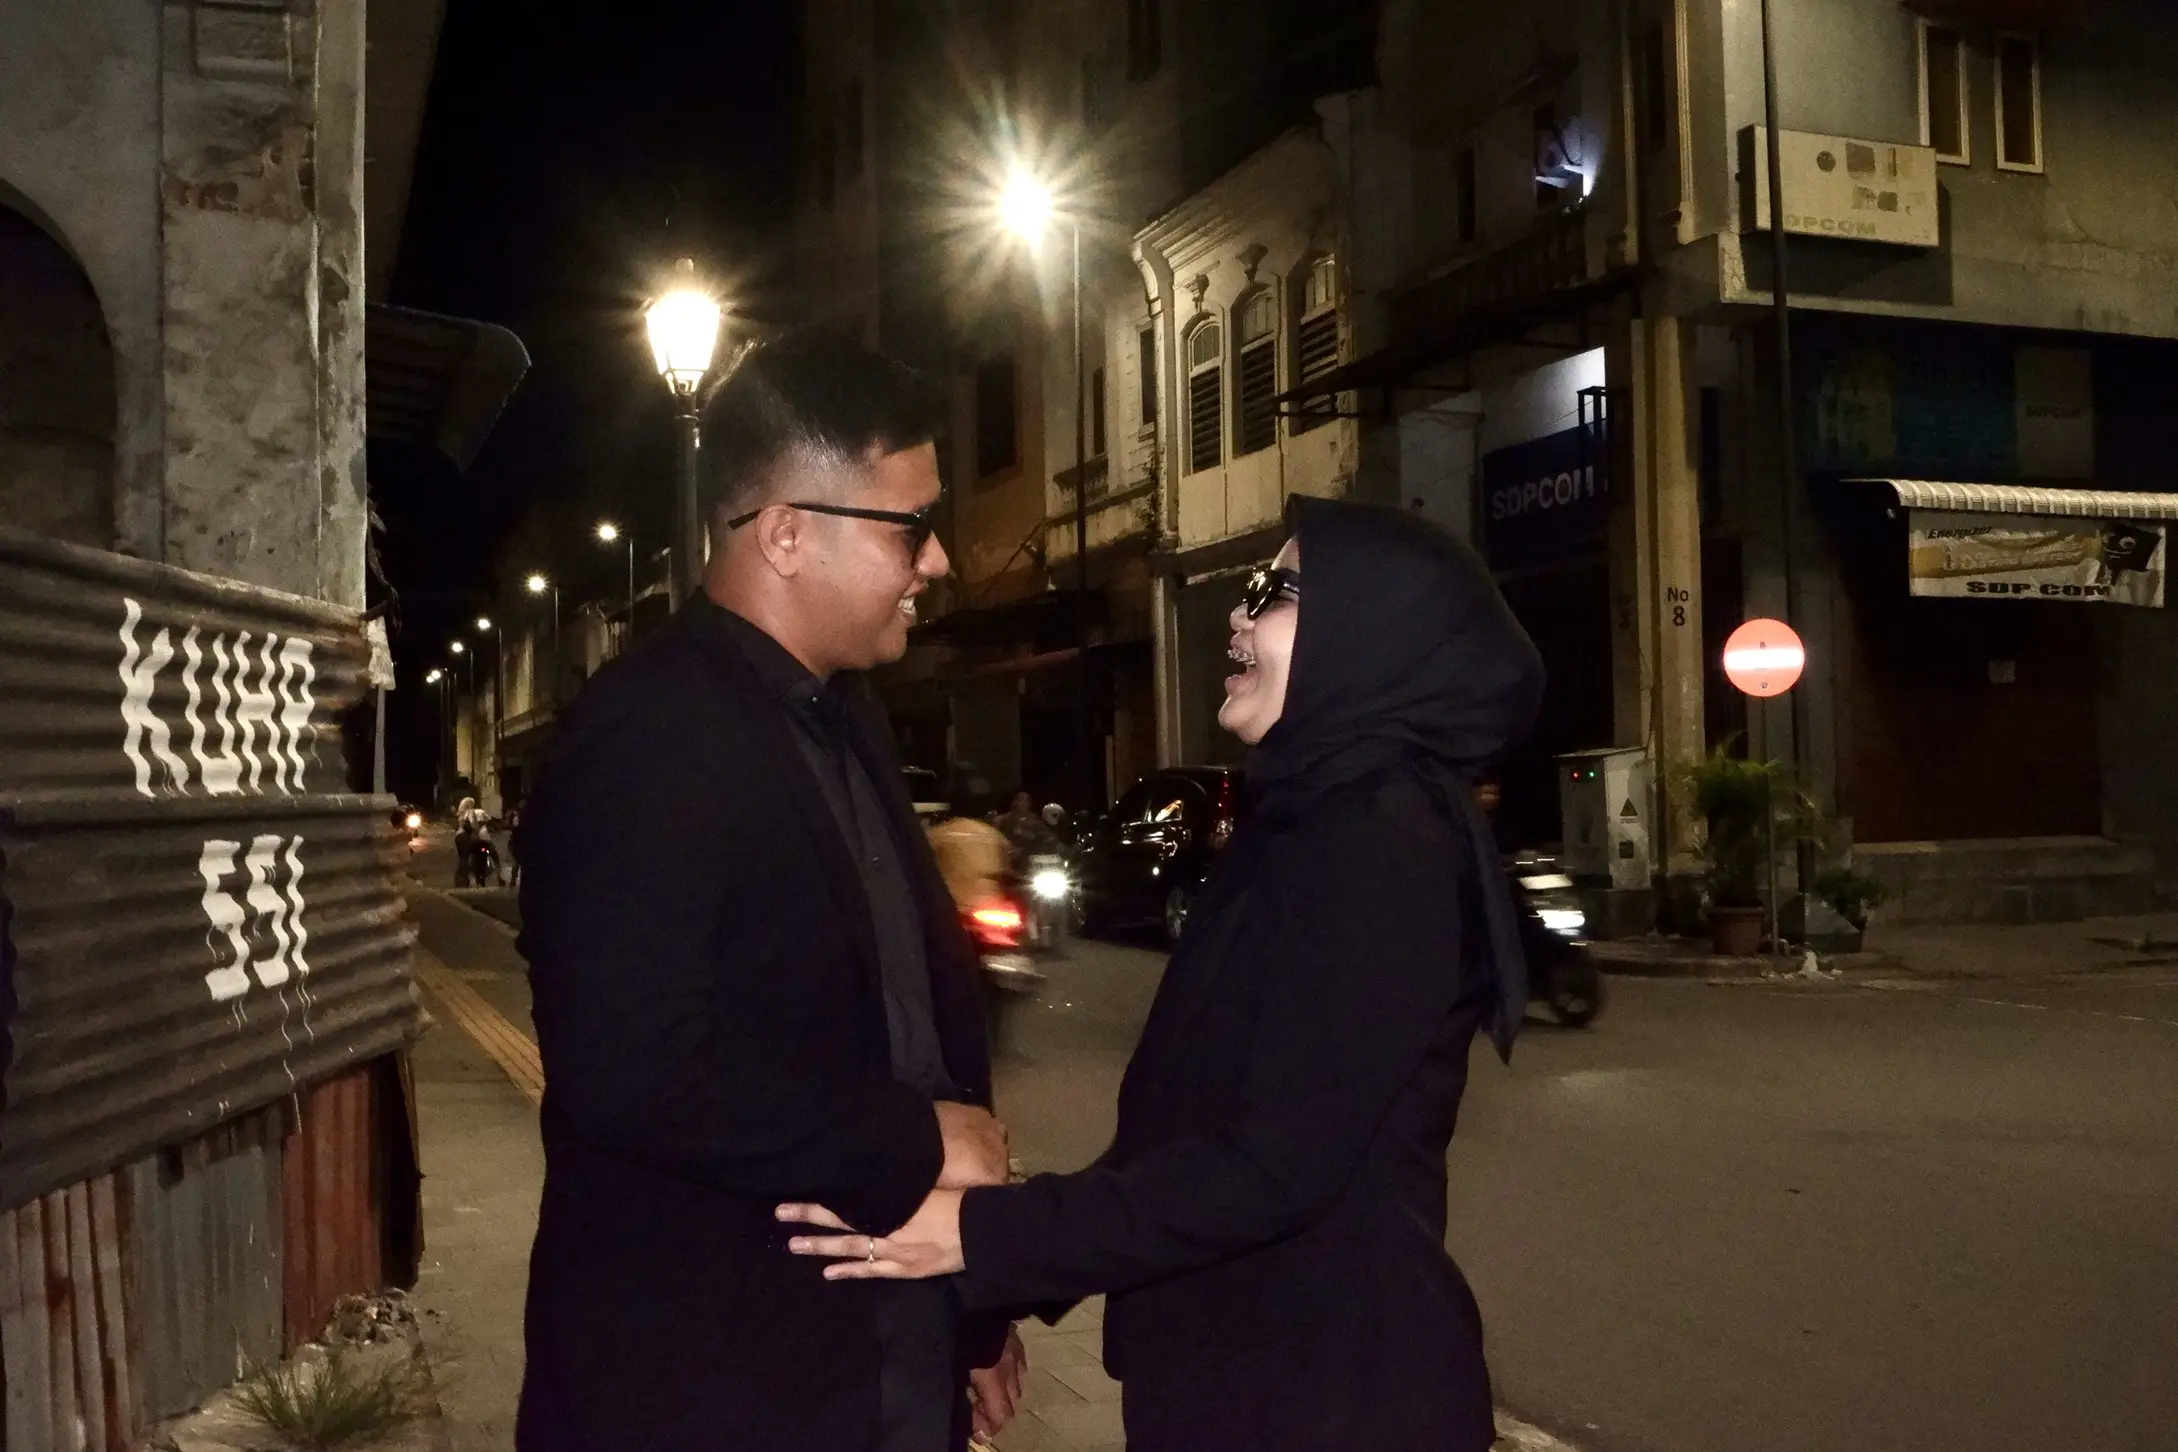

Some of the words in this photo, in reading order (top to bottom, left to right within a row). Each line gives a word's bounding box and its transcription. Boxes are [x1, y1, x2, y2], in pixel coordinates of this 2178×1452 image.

[1667, 587, 1689, 602] No
[1673, 605, 1685, 627] 8
[119, 597, 316, 798] KUHP
[199, 834, 309, 1001] 551
